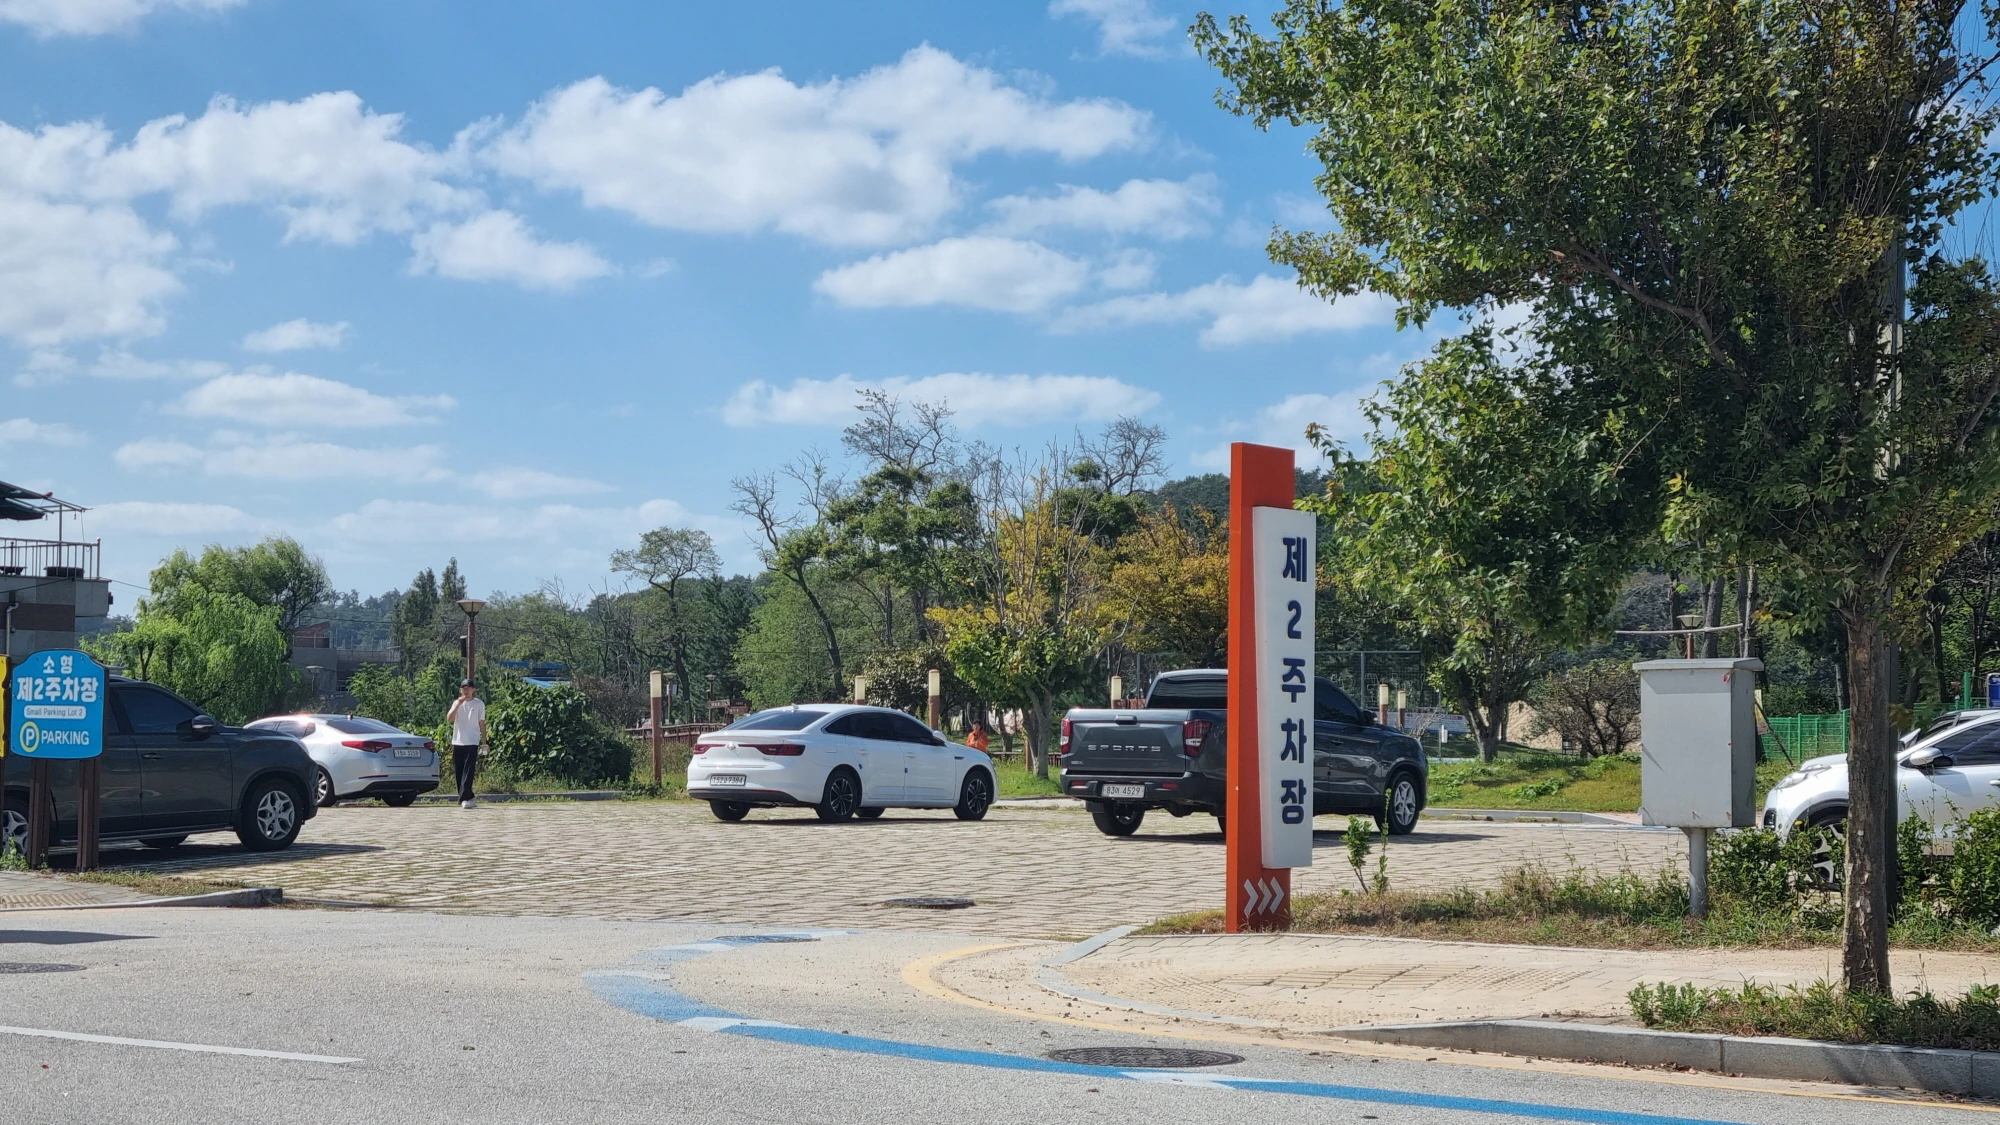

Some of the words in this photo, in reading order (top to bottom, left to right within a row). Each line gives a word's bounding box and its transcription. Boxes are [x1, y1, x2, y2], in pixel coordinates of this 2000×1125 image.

[1280, 536, 1308, 825] 제2주차장
[16, 677, 98, 702] 제2주차장
[26, 707, 42, 716] Small
[43, 707, 66, 717] Parking
[67, 708, 77, 716] Lot
[78, 708, 83, 716] 2
[25, 728, 35, 746] P
[41, 730, 90, 745] PARKING
[1088, 744, 1161, 752] SPORTS
[1122, 786, 1141, 795] 4529
